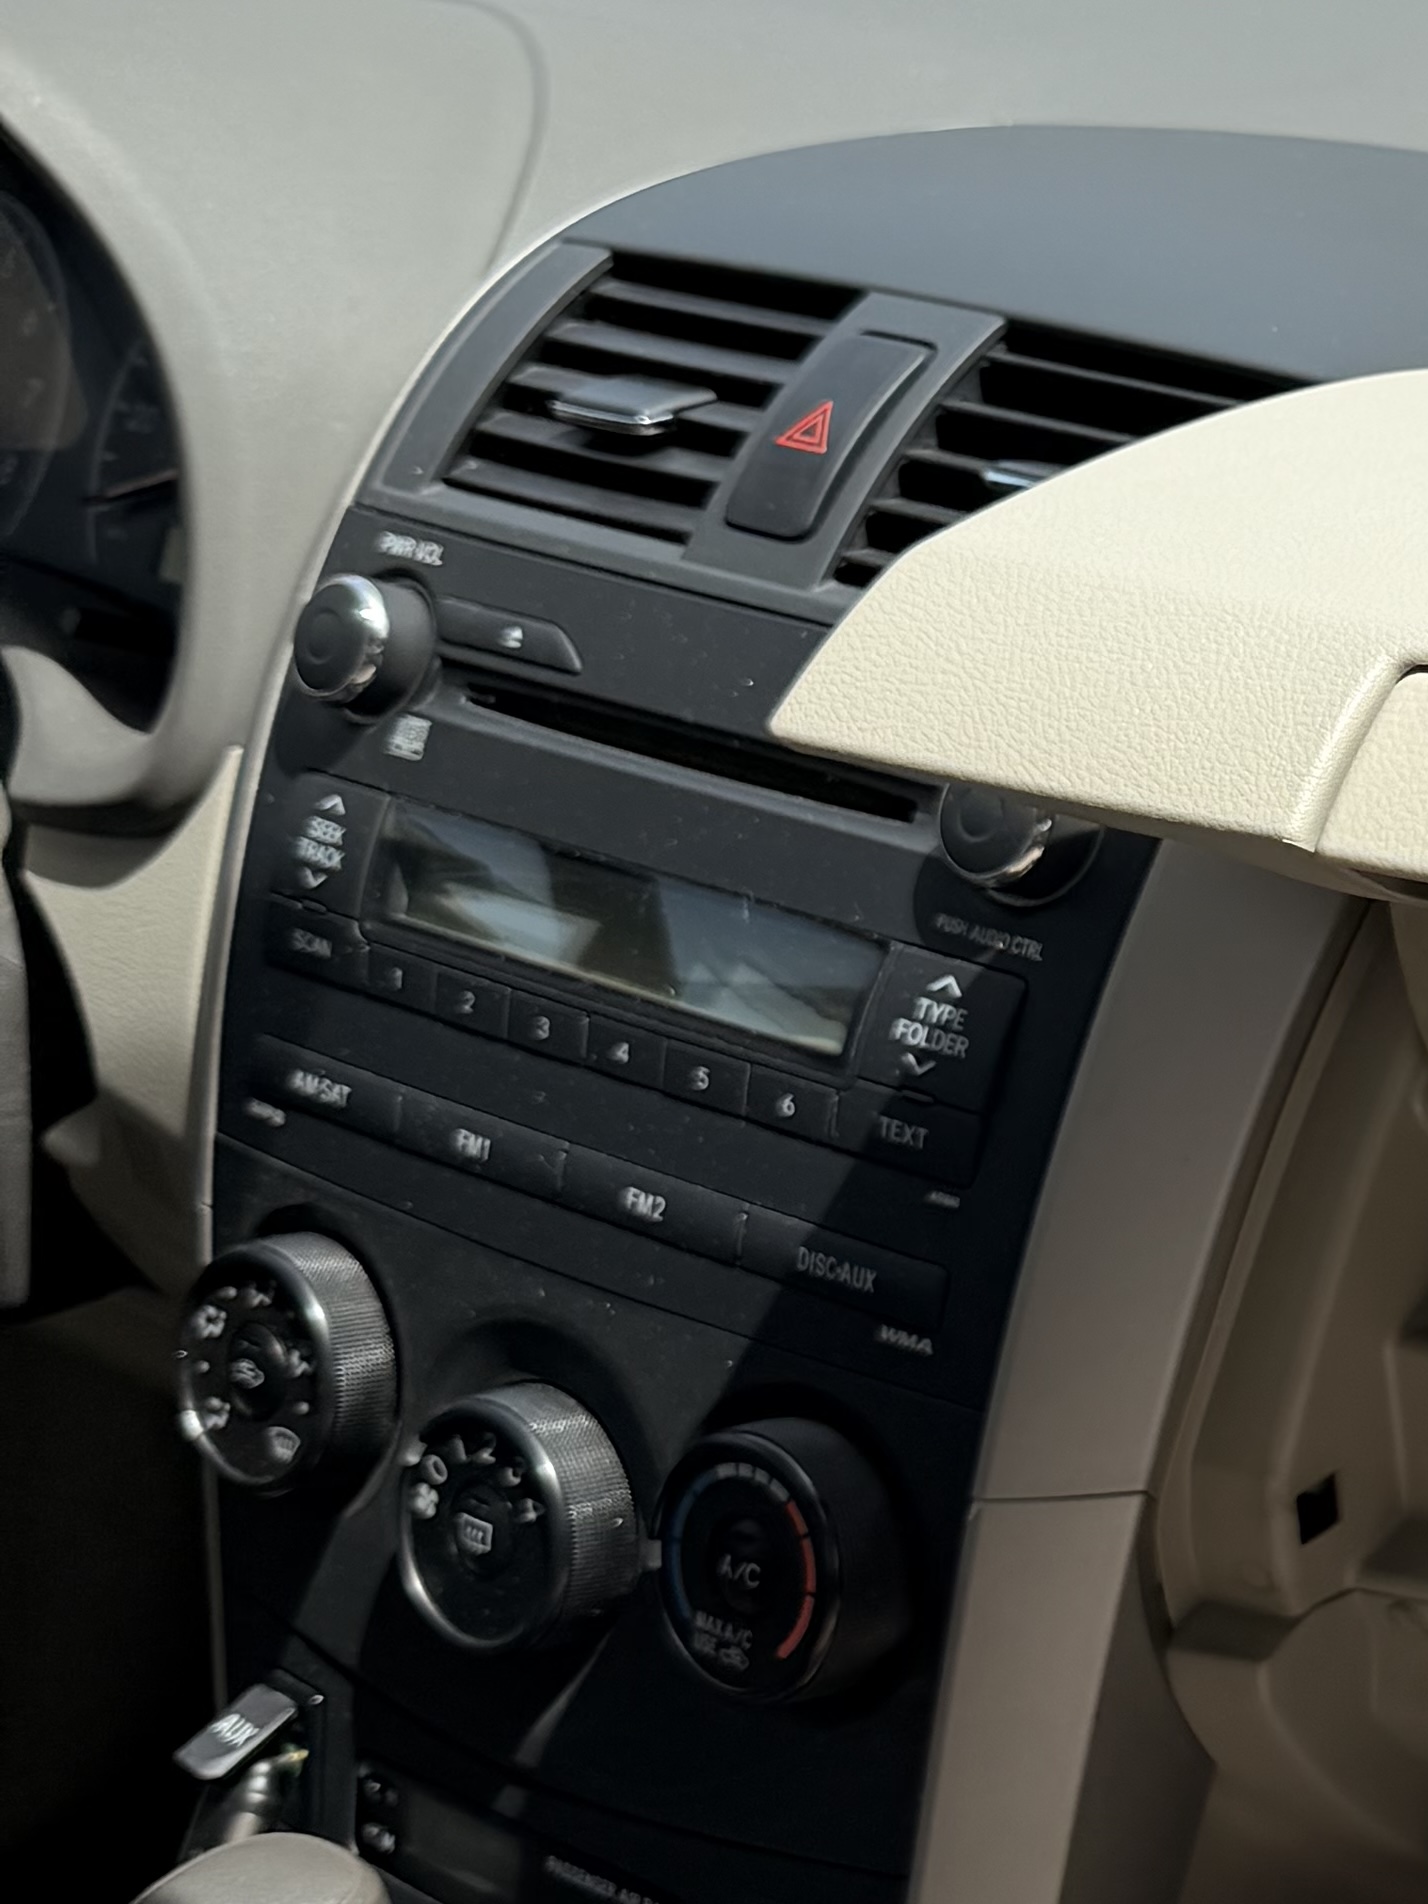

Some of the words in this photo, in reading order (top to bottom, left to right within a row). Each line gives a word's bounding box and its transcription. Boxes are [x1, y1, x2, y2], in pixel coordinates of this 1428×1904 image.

[458, 990, 477, 1015] 2
[912, 996, 969, 1030] TYPE
[534, 1015, 552, 1041] 3
[890, 1017, 970, 1059] FOLDER
[608, 1041, 631, 1065] 4
[691, 1066, 711, 1092] 5
[777, 1093, 797, 1119] 6
[878, 1115, 929, 1150] TEXT
[621, 1185, 667, 1223] FM2
[876, 1324, 933, 1356] WMA
[717, 1553, 762, 1590] A/C
[210, 1713, 260, 1747] AUX
